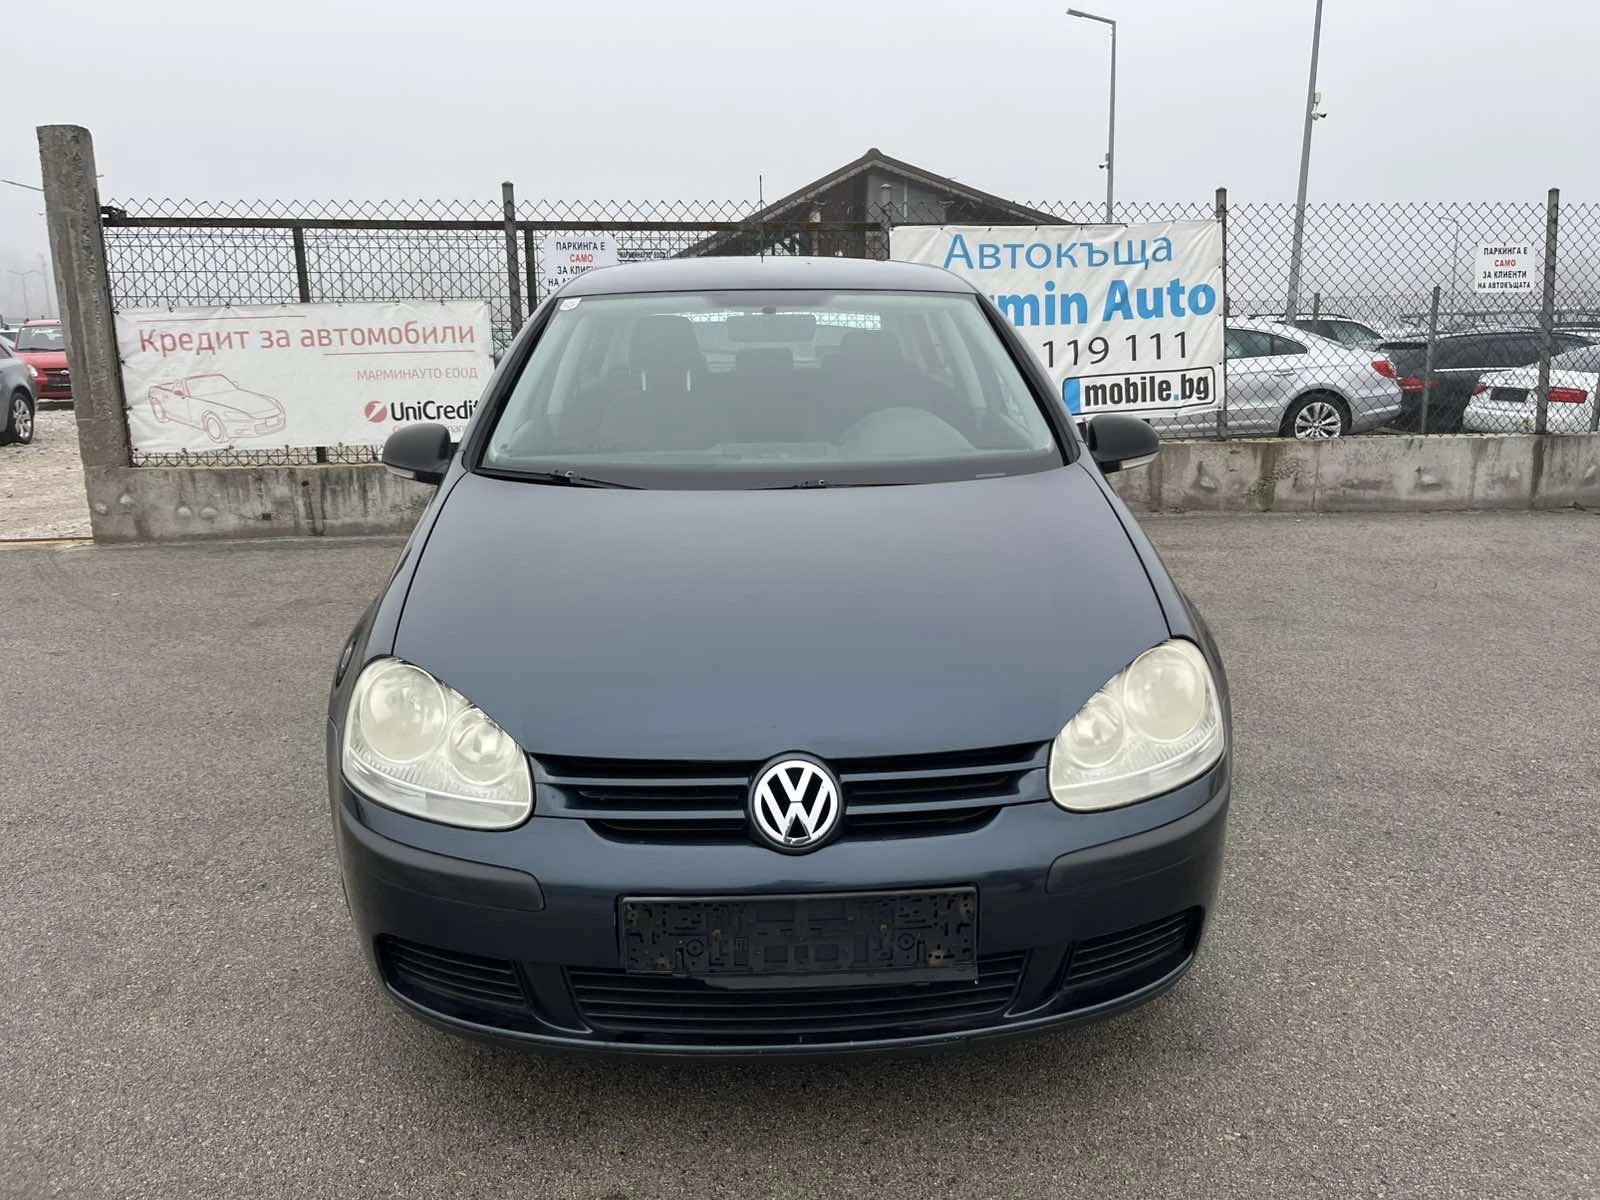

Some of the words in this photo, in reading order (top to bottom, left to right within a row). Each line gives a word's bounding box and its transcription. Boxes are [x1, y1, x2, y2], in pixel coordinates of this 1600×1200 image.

[556, 242, 598, 250] ПАРКИНГА
[601, 242, 606, 250] Е
[944, 233, 1173, 270] Автокъща
[1484, 247, 1521, 255] ПАРКИНГА
[569, 253, 594, 263] САМО
[556, 265, 568, 275] ЗА
[989, 280, 1088, 327] min
[1102, 277, 1216, 322] Auto
[138, 328, 249, 358] Кредит
[259, 328, 291, 349] за
[300, 320, 475, 347] автомобили
[1125, 331, 1187, 361] 111
[357, 367, 441, 381] МАРМИНАУТО
[445, 367, 479, 379] ЕООД
[1084, 373, 1210, 407] mobile.bg
